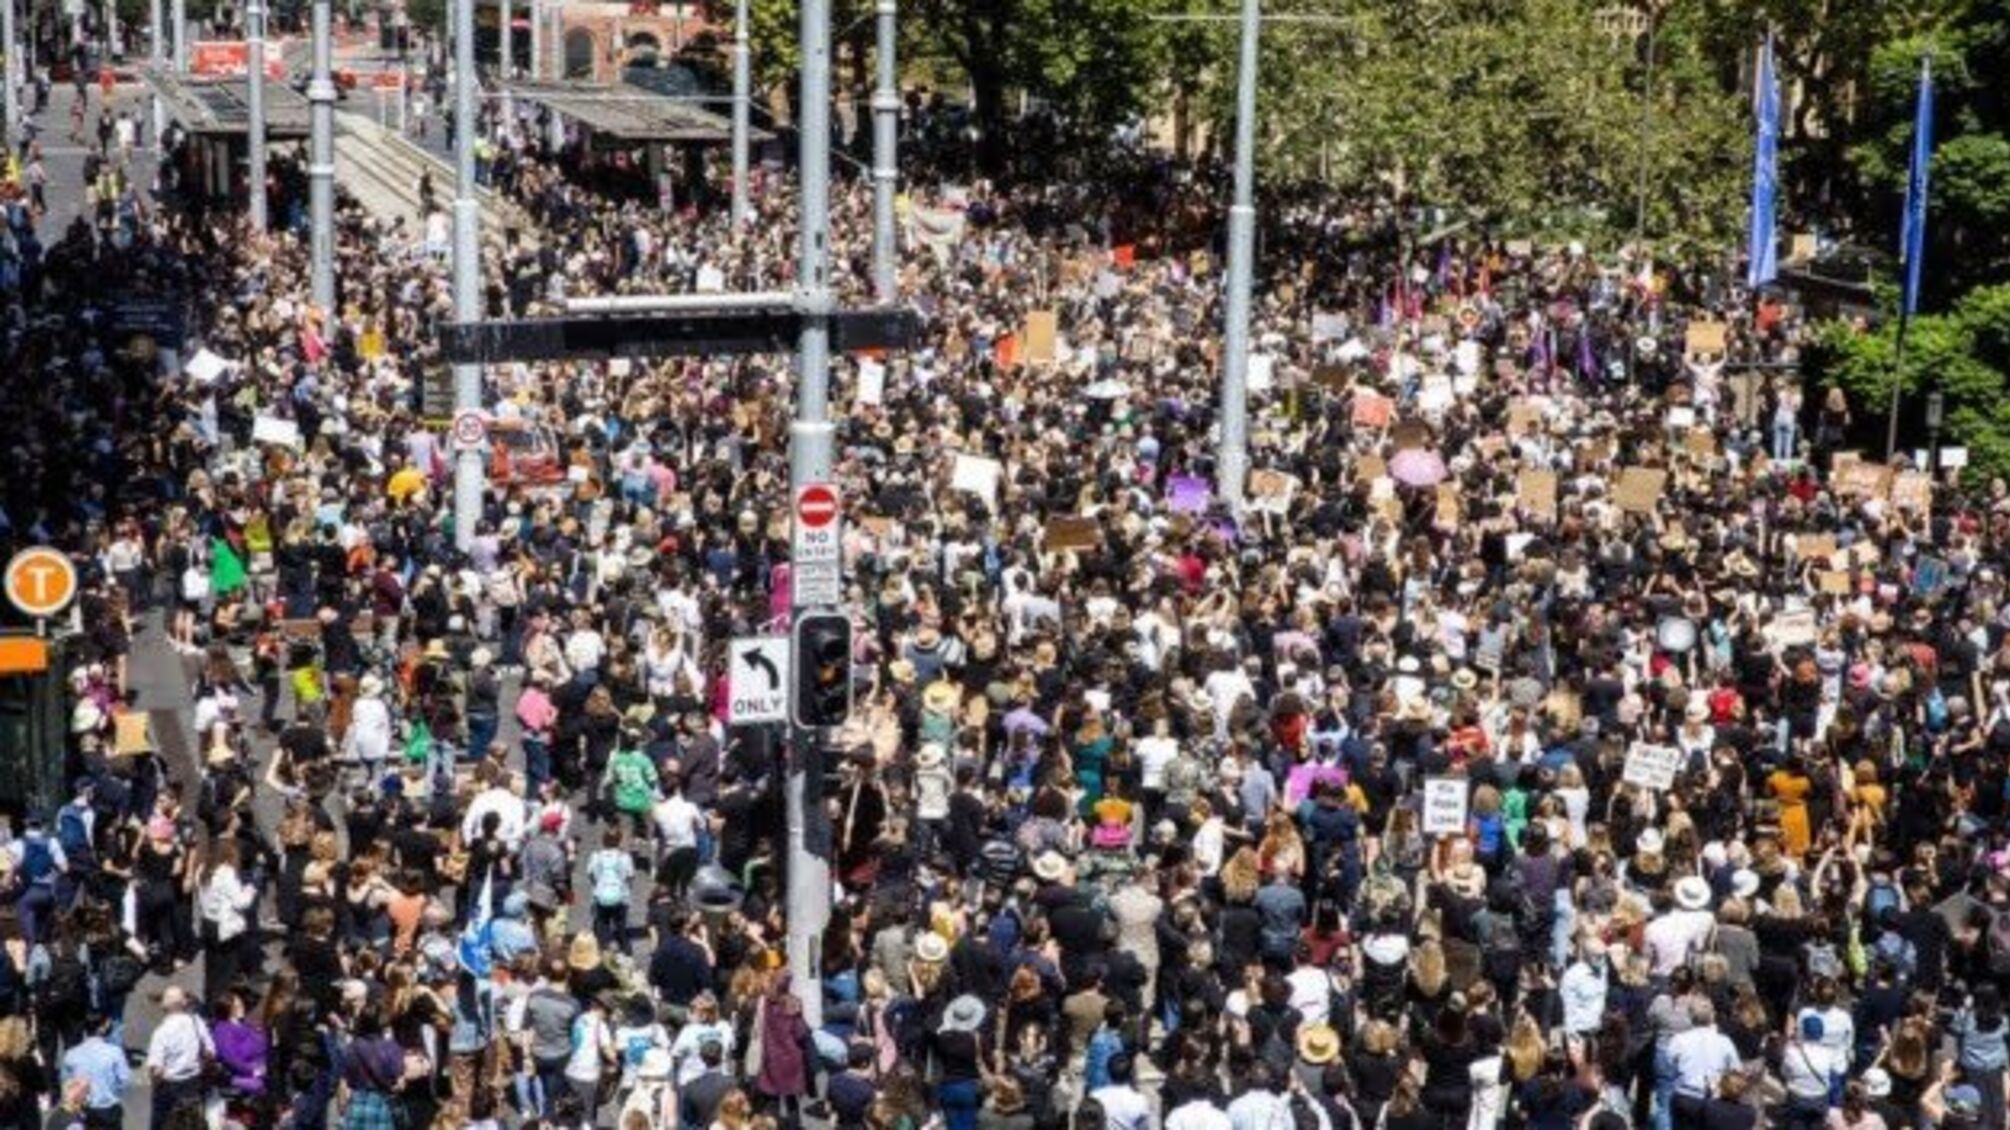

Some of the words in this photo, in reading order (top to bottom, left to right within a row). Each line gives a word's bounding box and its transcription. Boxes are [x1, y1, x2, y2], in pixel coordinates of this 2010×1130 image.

[805, 531, 829, 543] NO
[26, 567, 56, 602] T
[734, 697, 782, 714] ONLY
